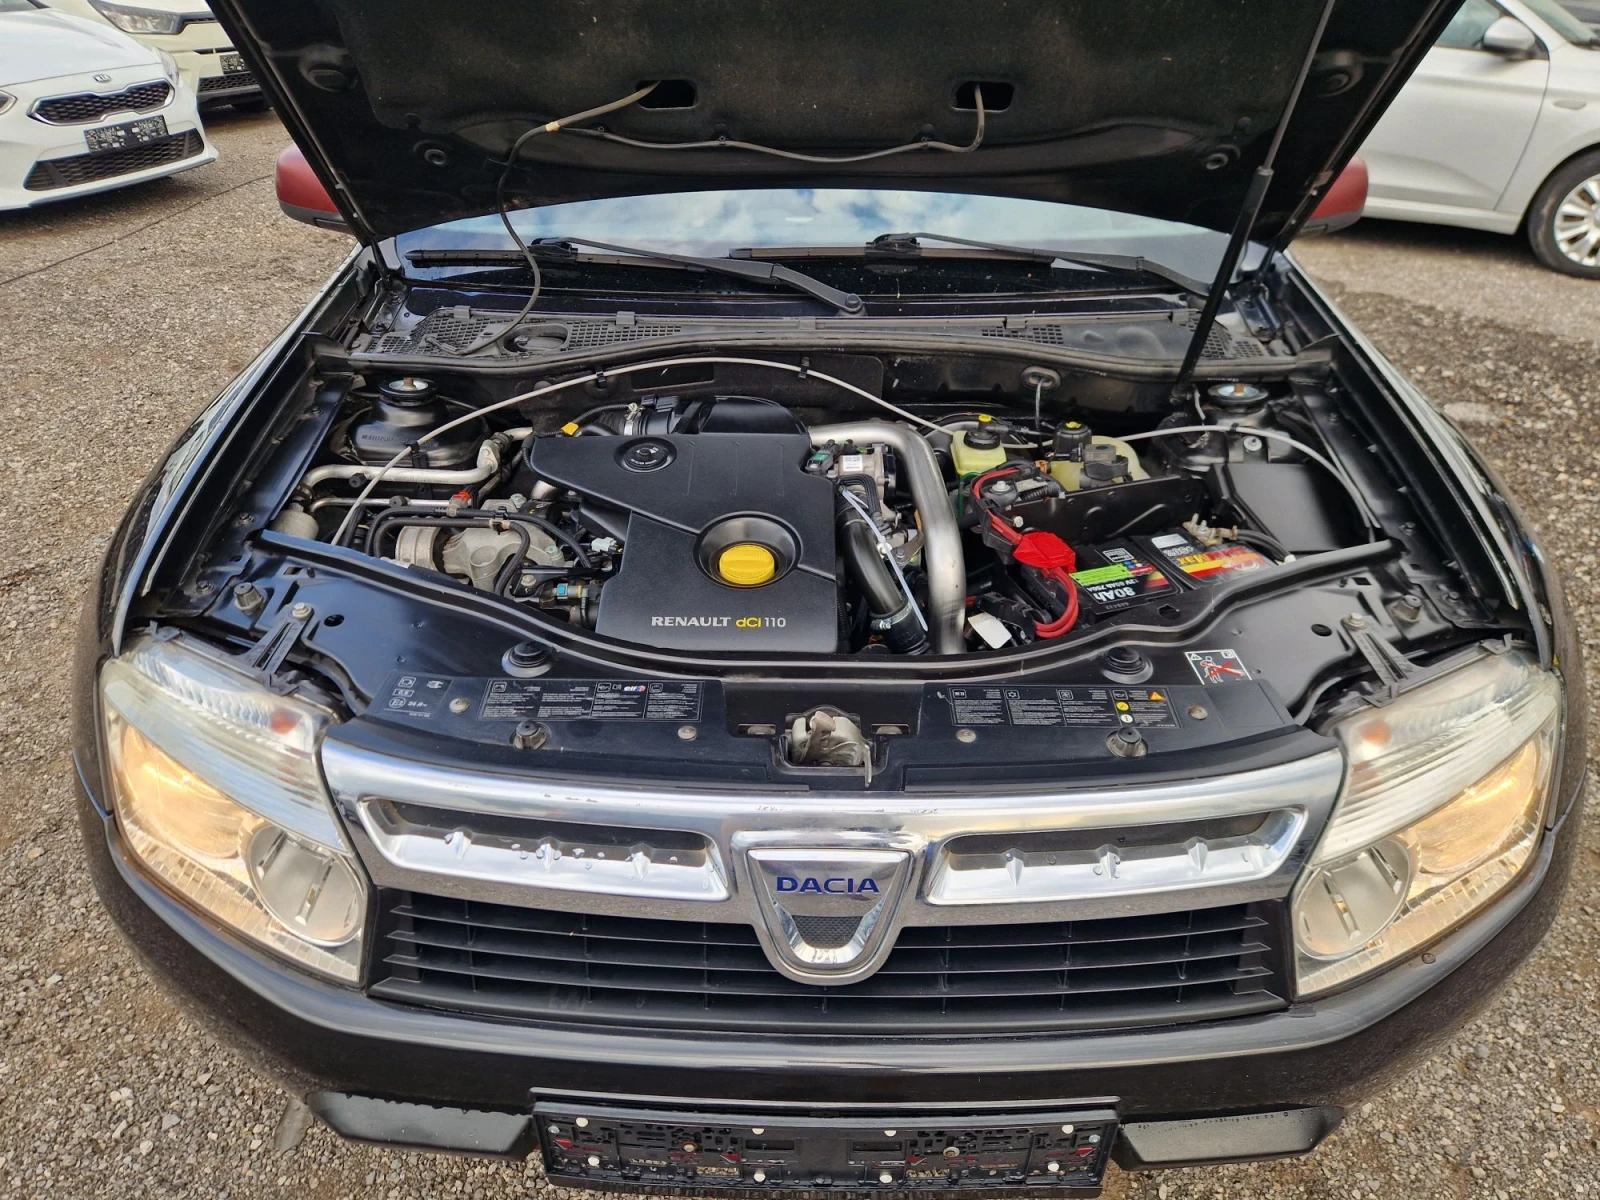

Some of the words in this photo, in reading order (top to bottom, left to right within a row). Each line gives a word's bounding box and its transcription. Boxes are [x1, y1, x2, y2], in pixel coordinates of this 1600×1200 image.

[1093, 586, 1136, 602] 80Ah
[651, 616, 731, 627] RENAULT
[764, 617, 787, 628] 110
[776, 876, 880, 894] DACIA
